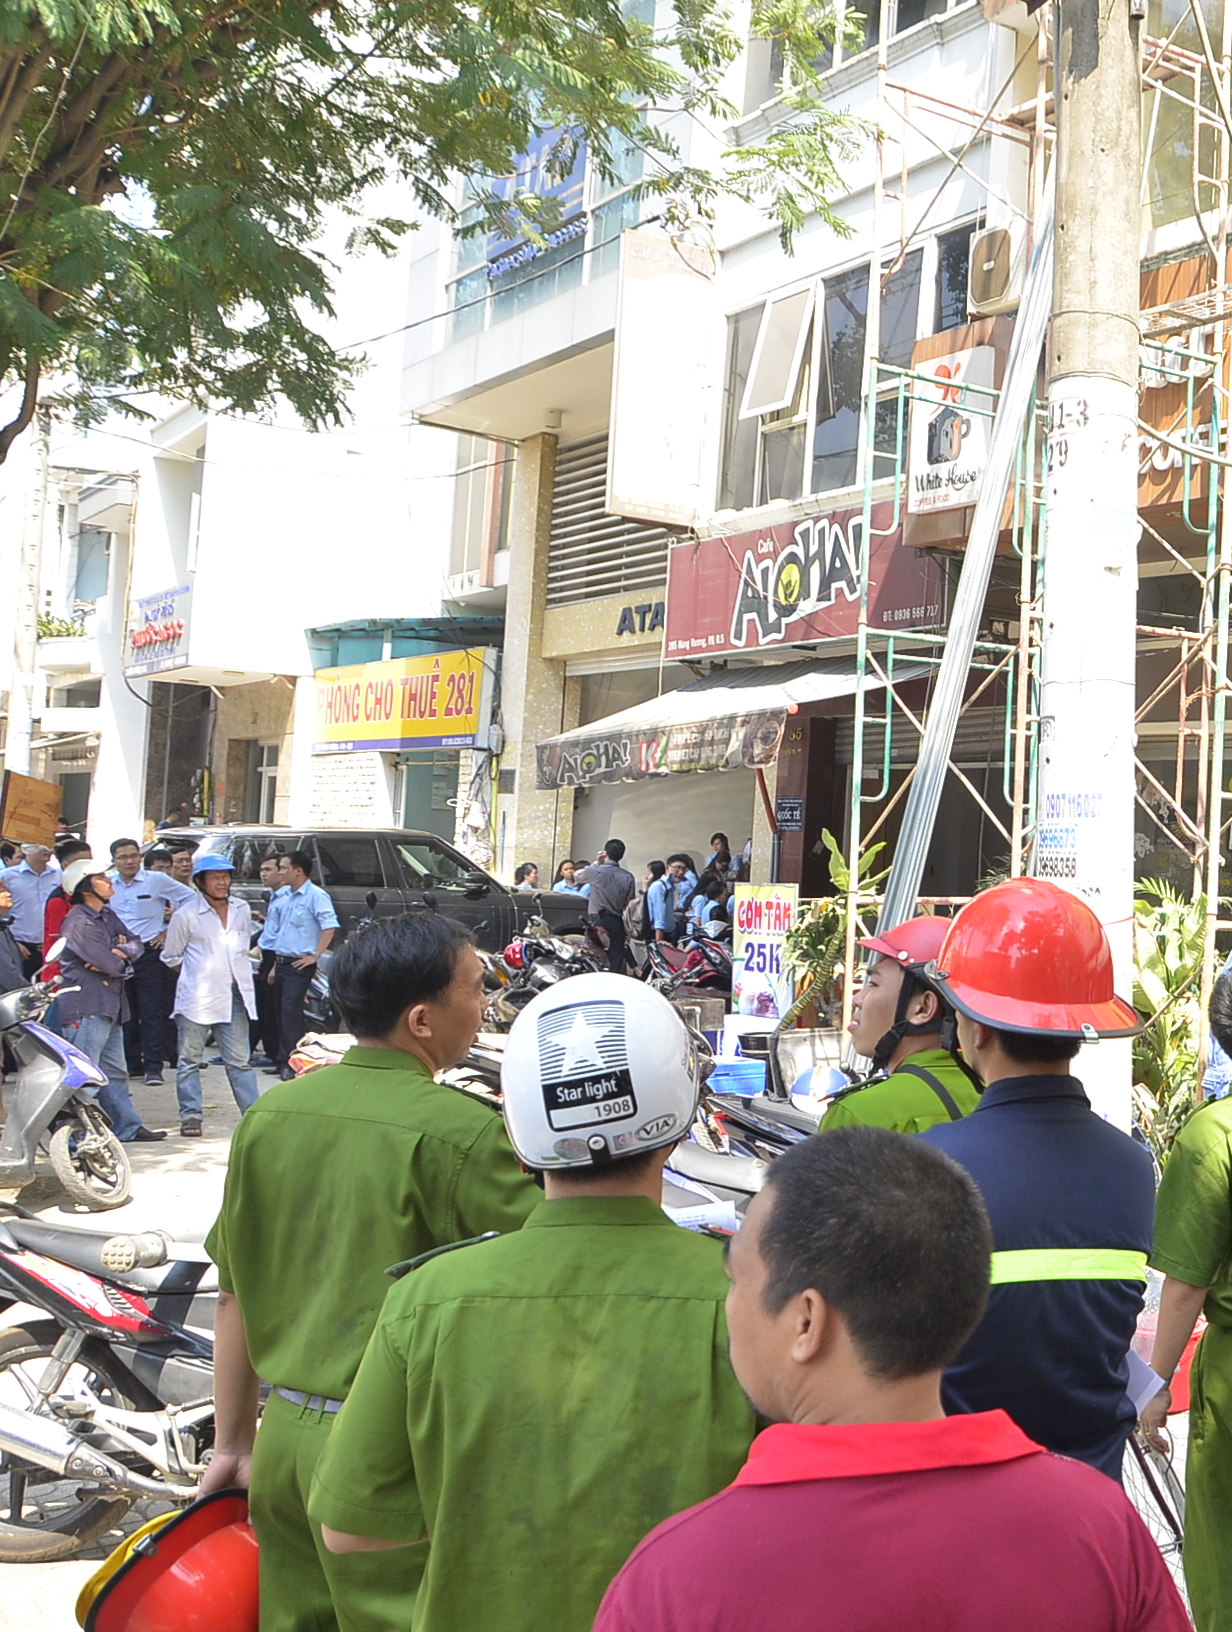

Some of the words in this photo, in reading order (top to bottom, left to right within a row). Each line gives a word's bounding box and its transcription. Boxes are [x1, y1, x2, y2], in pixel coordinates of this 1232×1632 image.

[915, 472, 943, 493] White
[945, 462, 977, 491] House
[317, 673, 361, 725] PHÒNG
[364, 678, 394, 723] CHO
[399, 657, 441, 721] THUÊ
[443, 670, 476, 718] 281
[556, 1083, 583, 1103] Star
[585, 1077, 619, 1100] light
[593, 1099, 632, 1118] 1908
[640, 1116, 671, 1137] VIA
